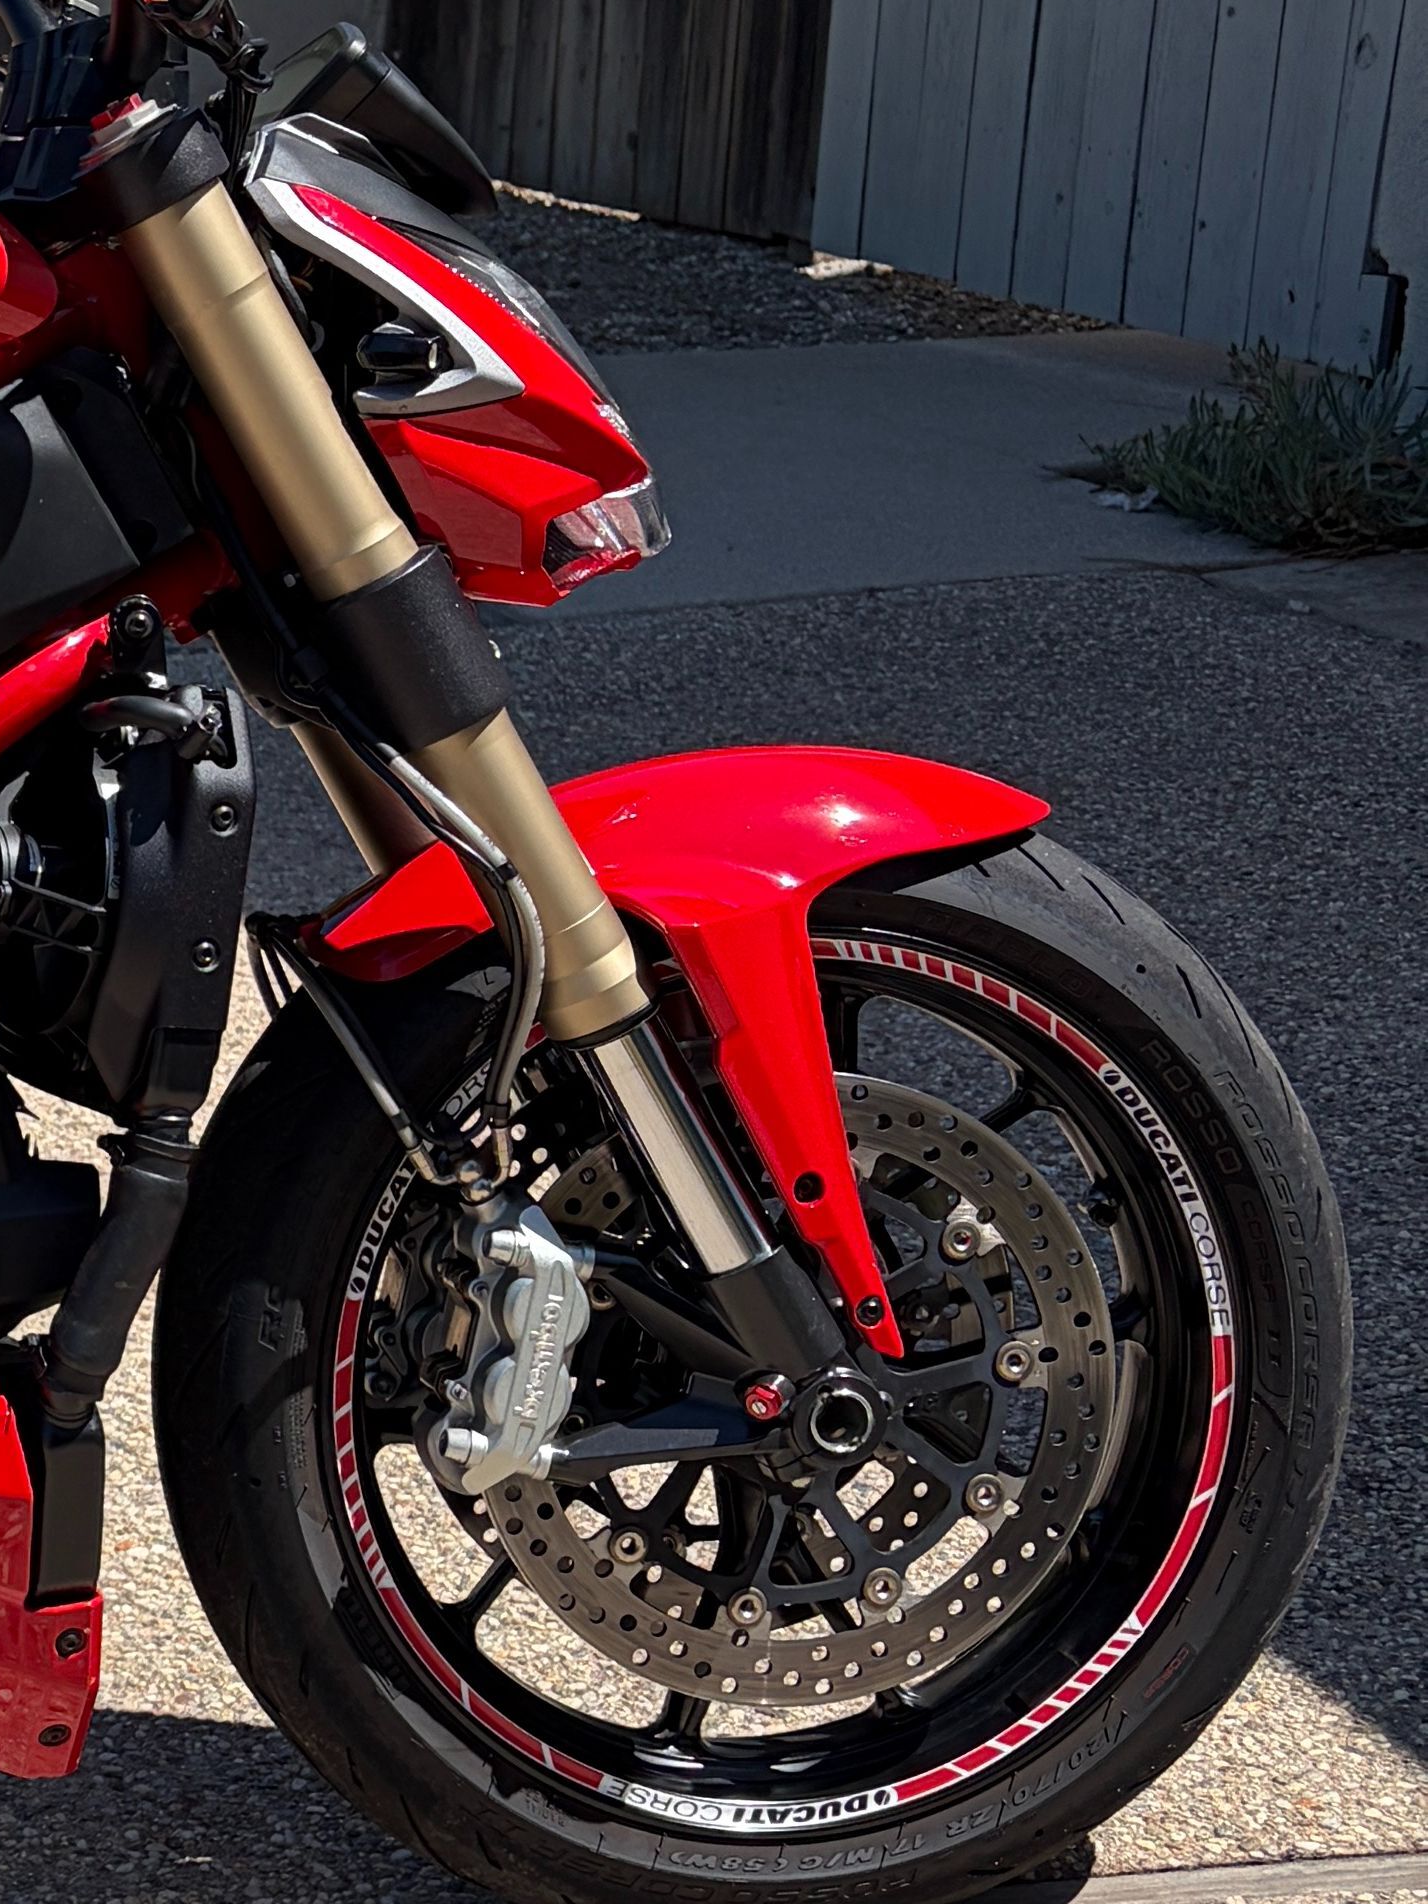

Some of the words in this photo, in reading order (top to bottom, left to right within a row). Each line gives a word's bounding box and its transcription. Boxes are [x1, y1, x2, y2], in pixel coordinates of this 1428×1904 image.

[1138, 1036, 1243, 1176] ROSSO
[355, 1157, 421, 1273] DUCAT
[1111, 1078, 1199, 1205] DUCATI
[1185, 1209, 1230, 1328] CORSE
[1212, 1068, 1306, 1246] ROSSO
[1290, 1254, 1319, 1451] CORSA
[1008, 1725, 1114, 1806] 120/70
[605, 1776, 722, 1822] CORSE
[731, 1793, 870, 1822] DUCATI
[942, 1804, 998, 1838] ZR
[798, 1845, 876, 1869] M/C
[892, 1832, 926, 1853] 17
